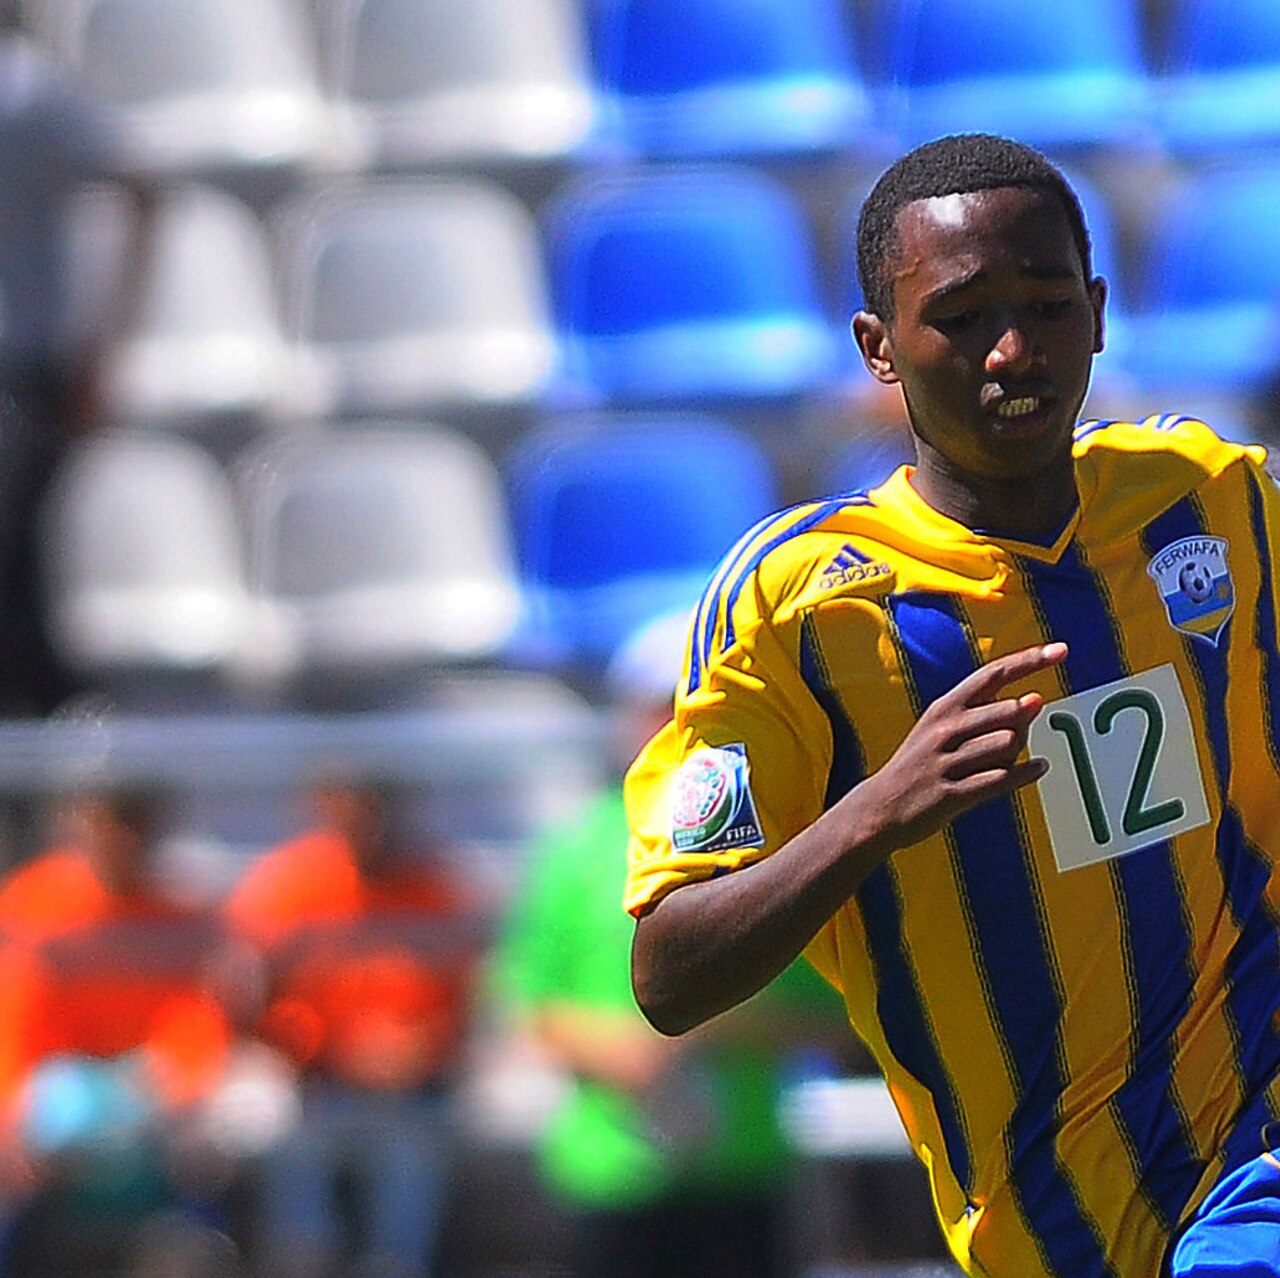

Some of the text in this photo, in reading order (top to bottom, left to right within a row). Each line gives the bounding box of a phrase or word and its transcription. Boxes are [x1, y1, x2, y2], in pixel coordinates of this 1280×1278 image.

[1155, 541, 1220, 574] FERWAFA
[820, 563, 891, 589] adidas
[1049, 688, 1186, 844] 12
[726, 825, 756, 840] FIFA
